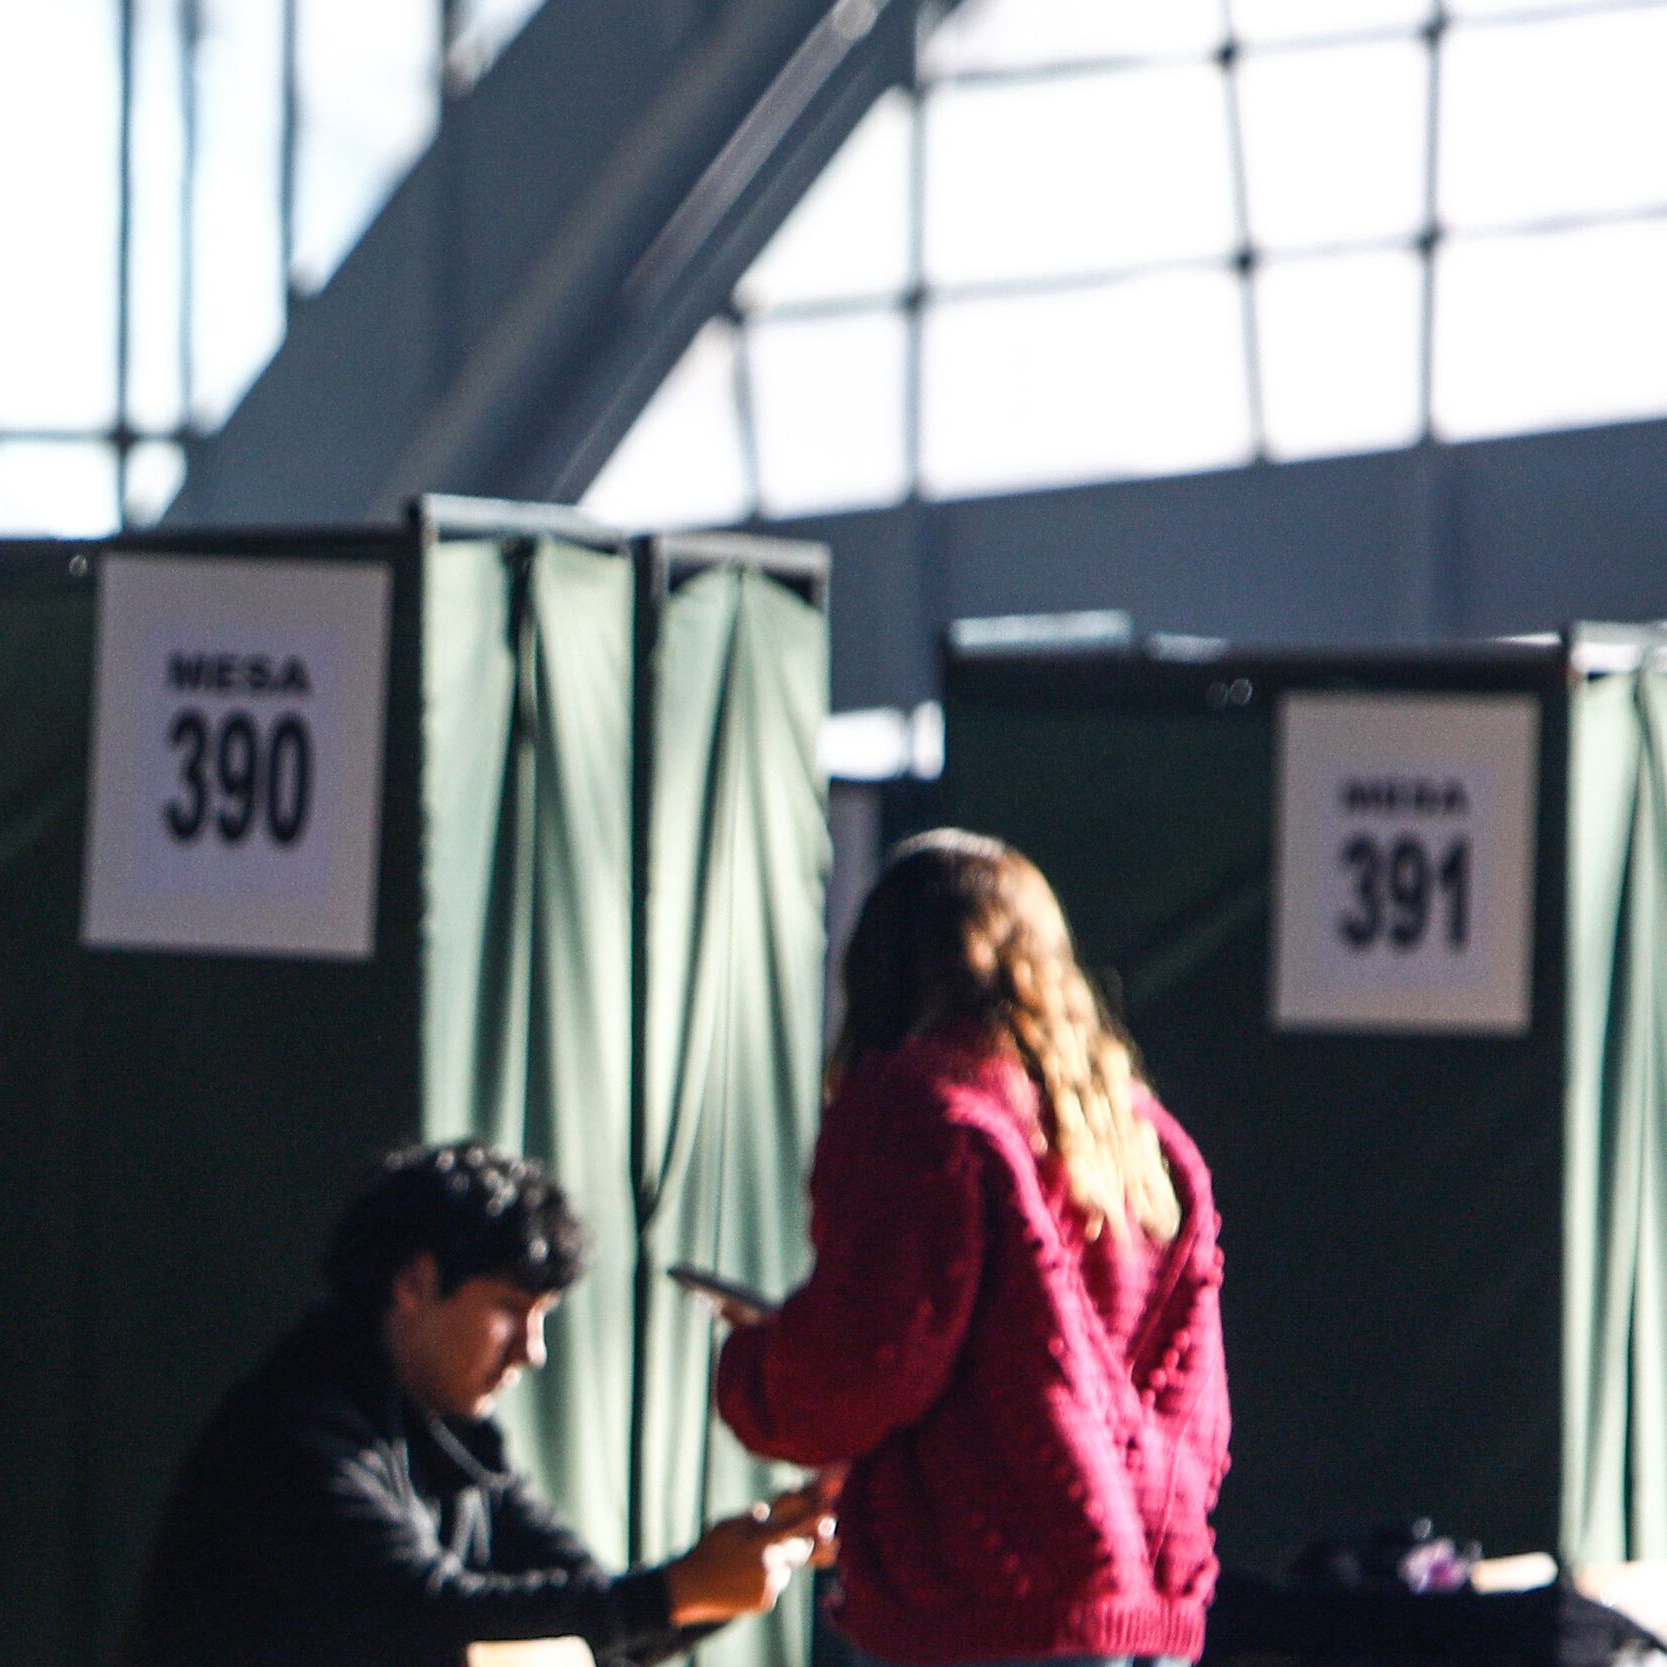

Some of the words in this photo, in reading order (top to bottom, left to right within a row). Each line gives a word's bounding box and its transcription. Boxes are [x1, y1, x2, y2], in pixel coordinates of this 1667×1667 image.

[167, 650, 312, 691] MESA
[165, 707, 314, 846] 390
[1339, 834, 1469, 952] 391
